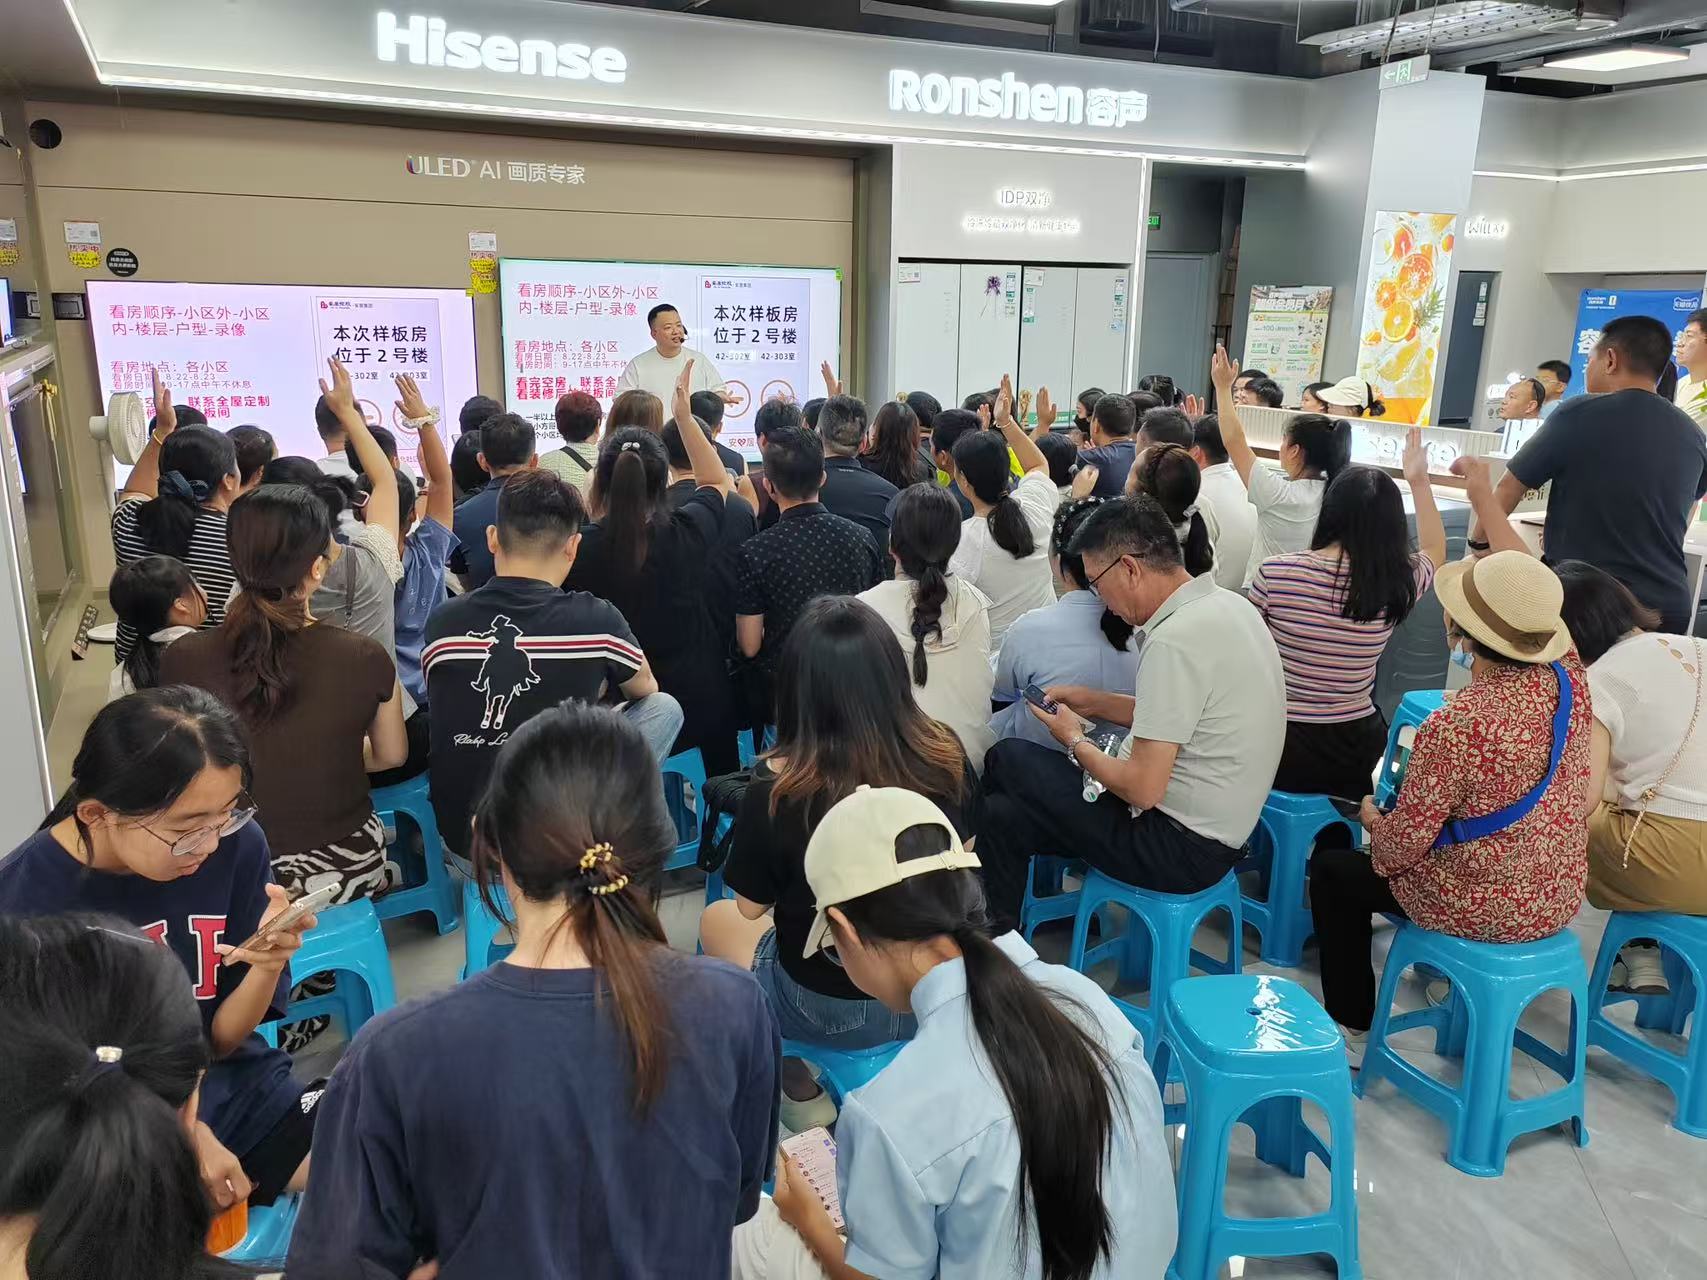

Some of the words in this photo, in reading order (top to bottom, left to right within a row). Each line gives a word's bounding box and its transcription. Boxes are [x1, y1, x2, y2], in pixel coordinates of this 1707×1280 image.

[377, 11, 628, 84] Hisense
[889, 69, 1084, 125] Ronshen
[1086, 87, 1148, 127] 容声
[479, 160, 502, 180] AI
[507, 161, 586, 185] 画质专家
[518, 282, 660, 300] 看房顺序-小区外-小区
[109, 304, 270, 321] 看房顺序-小区外-小区
[519, 301, 639, 316] 内-楼层-户型-录像
[713, 304, 798, 323] 本次样板房
[112, 321, 247, 337] 内-楼层-户型-录像
[333, 324, 428, 343] 本次样板房
[713, 327, 798, 345] 位于2号楼
[515, 360, 628, 369] 看房时间：9-17点中午不休
[350, 371, 380, 380] -302室
